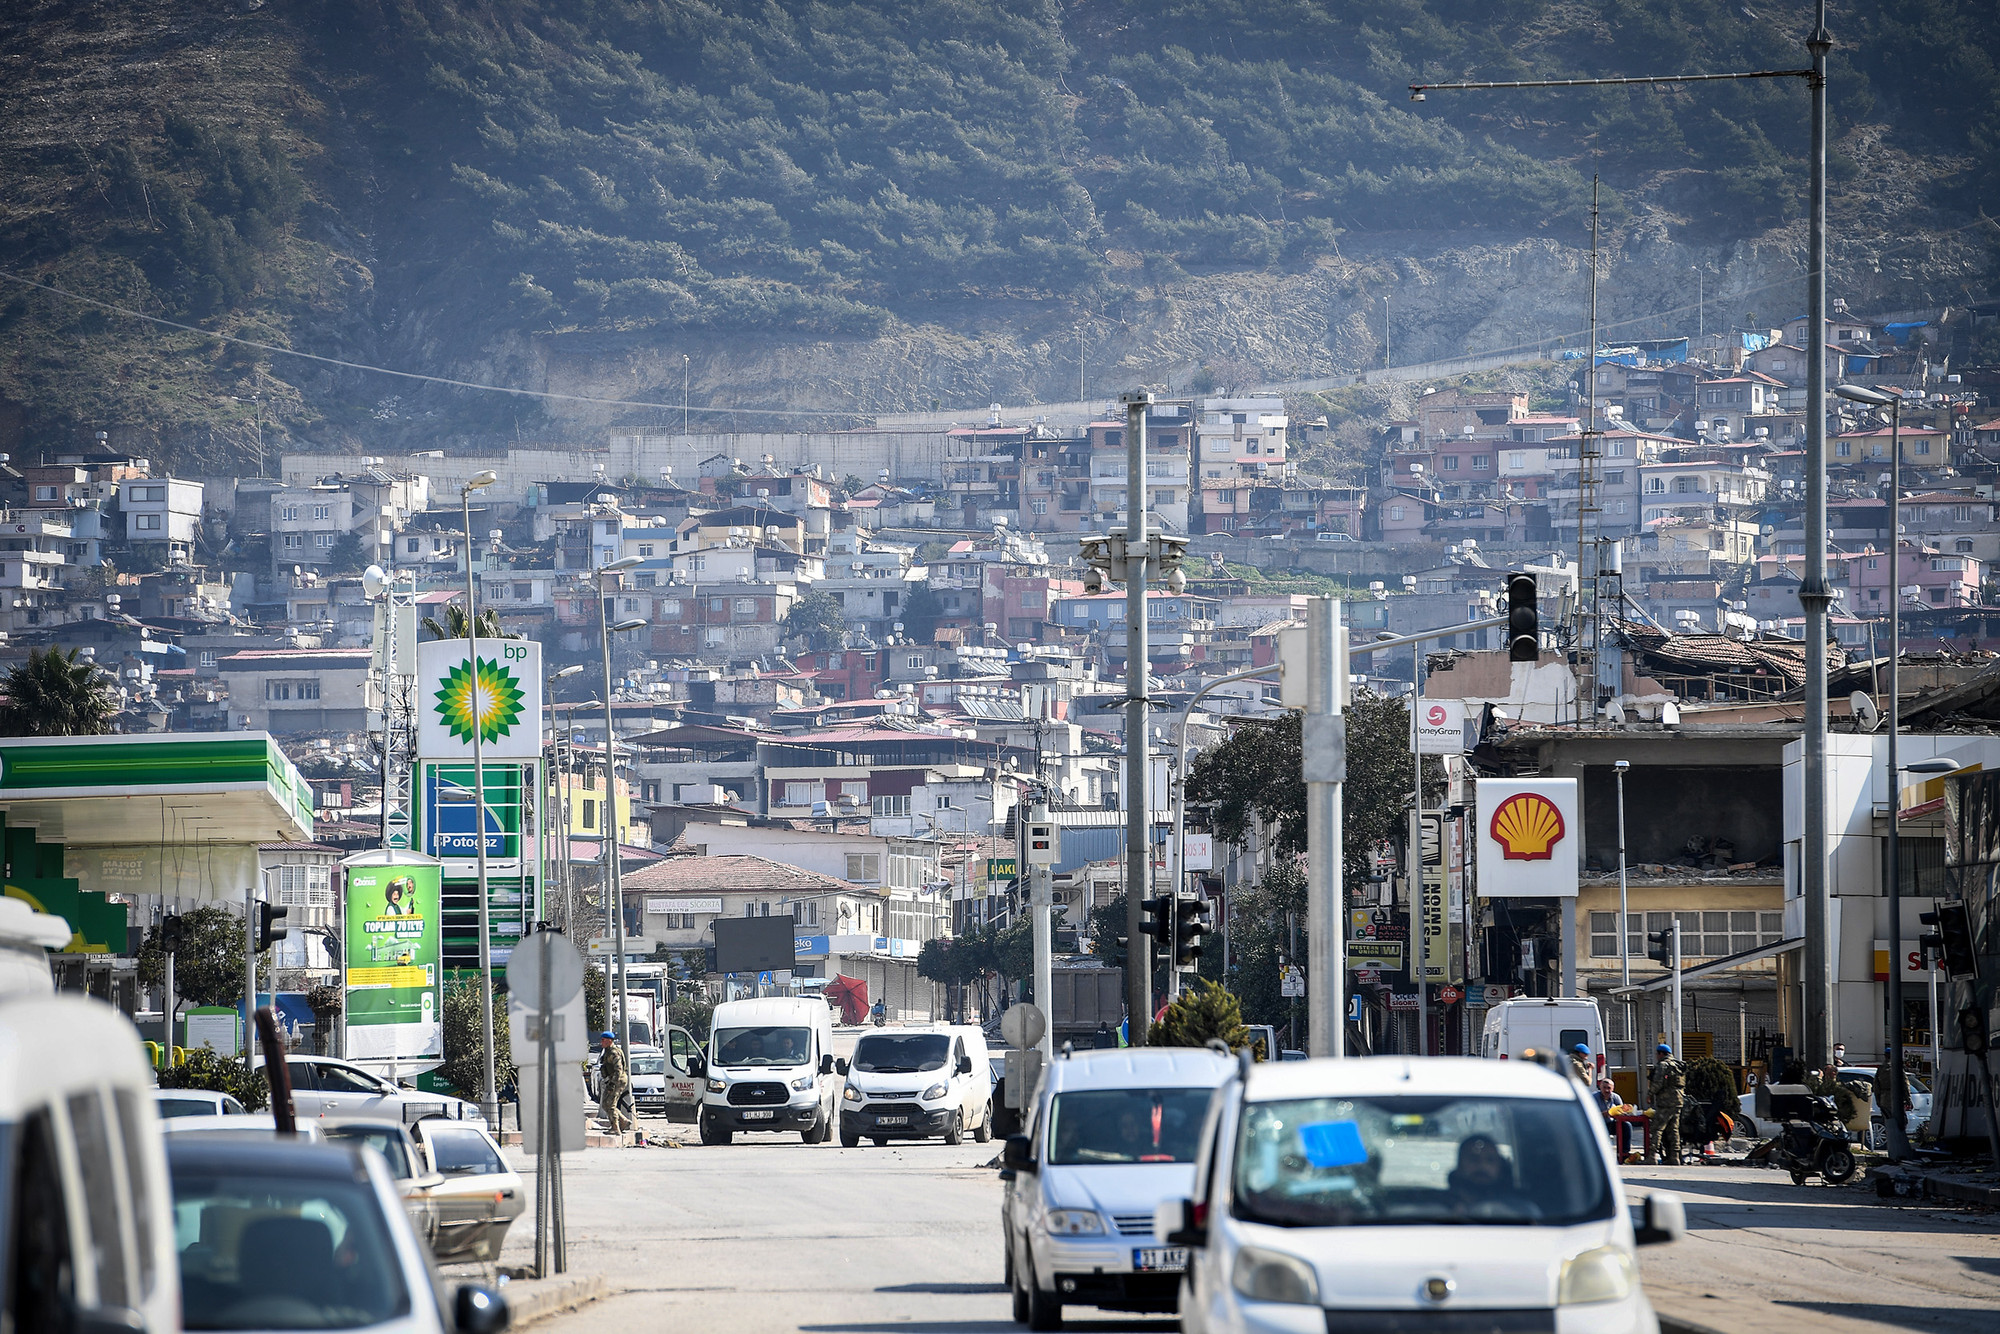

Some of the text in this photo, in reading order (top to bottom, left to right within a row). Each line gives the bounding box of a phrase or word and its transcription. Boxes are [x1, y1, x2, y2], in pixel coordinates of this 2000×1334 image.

[504, 643, 527, 662] bp
[690, 900, 720, 908] SİGORTA
[1431, 884, 1441, 936] UNION
[365, 921, 396, 932] TOPLAM
[397, 921, 406, 931] 70
[794, 939, 812, 948] eko
[1443, 989, 1457, 998] ria
